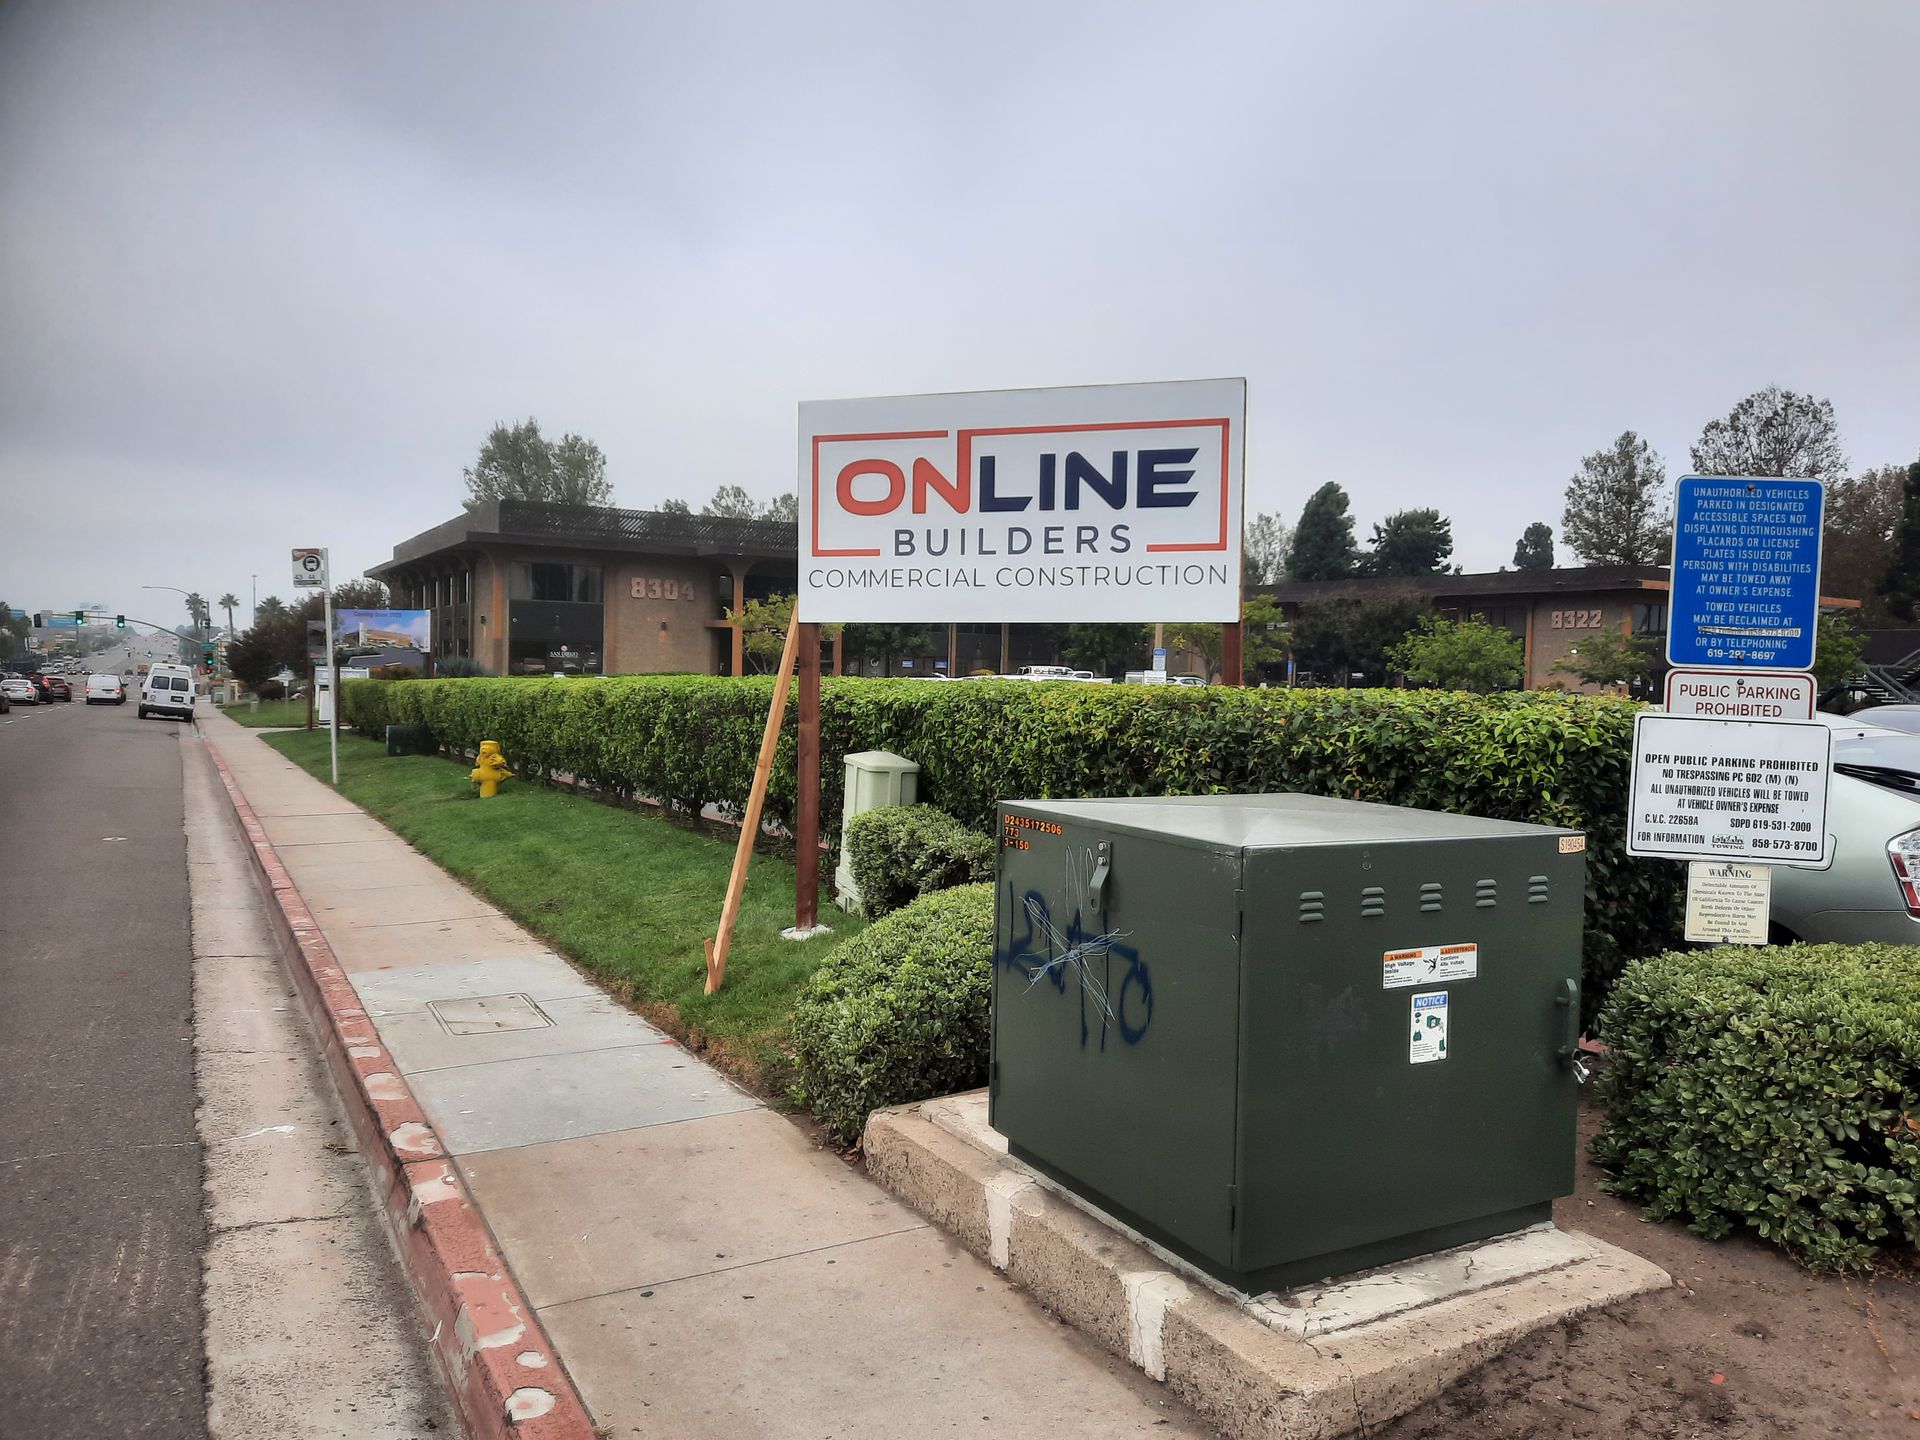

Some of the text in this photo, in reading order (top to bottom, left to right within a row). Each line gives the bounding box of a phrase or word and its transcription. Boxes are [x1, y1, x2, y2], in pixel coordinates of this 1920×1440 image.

[835, 440, 1199, 516] ONLINE
[1766, 490, 1809, 499] VEHICLES
[1698, 500, 1804, 511] PARKED IN DESIGNATED
[1693, 512, 1807, 524] ACCESSIBLE SPACES NOT
[1684, 524, 1814, 536] DISPLAYING DISTINGUISHING
[894, 524, 1132, 556] BUILDERS
[1697, 537, 1800, 548] PLACARDS OR LICENSE
[1704, 550, 1792, 560] PLATES ISSUED FOR
[1683, 561, 1811, 573] PERSONS WITH DISABILITIES
[808, 564, 1228, 589] COMMERCIAL CONSTRUCTION
[1702, 574, 1791, 584] MAY BE TOWED AWAY
[631, 577, 694, 600] 8304
[1696, 585, 1794, 597] AT OWNER'S EXPENSE.
[1706, 602, 1781, 613] TOWED VEHICLES
[1552, 610, 1602, 628] 8322
[1693, 614, 1793, 626] MAY BE RECLAIMED AT
[1696, 638, 1787, 649] OR BY TELEPHONING
[1680, 684, 1800, 700] PUBLIC PARKING
[1696, 702, 1782, 717] PROHIBITED
[1645, 754, 1818, 771] OPEN PUBLIC PARKING PROHIBITED
[1662, 769, 1798, 786] NO TRESPASSING PC 602 (M) (N)
[1651, 784, 1809, 801] ALL UNAUTHORIZED VEHICLES WILL BE TOWED
[1677, 799, 1779, 813] AT VEHICLE OWNER'S EXPENSE
[1005, 815, 1062, 835] D2435172506
[1645, 814, 1698, 825] C.V.C. 22658A
[1730, 818, 1811, 832] SDPD 619-531-2000
[1005, 827, 1019, 837] 773
[1638, 832, 1651, 841] FOR
[1654, 832, 1705, 844] INFORMATION
[1005, 838, 1029, 850] 3-150
[1752, 839, 1817, 851] 858-573-8700
[1709, 869, 1751, 878] WARNING
[1416, 996, 1444, 1007] NOTICE
